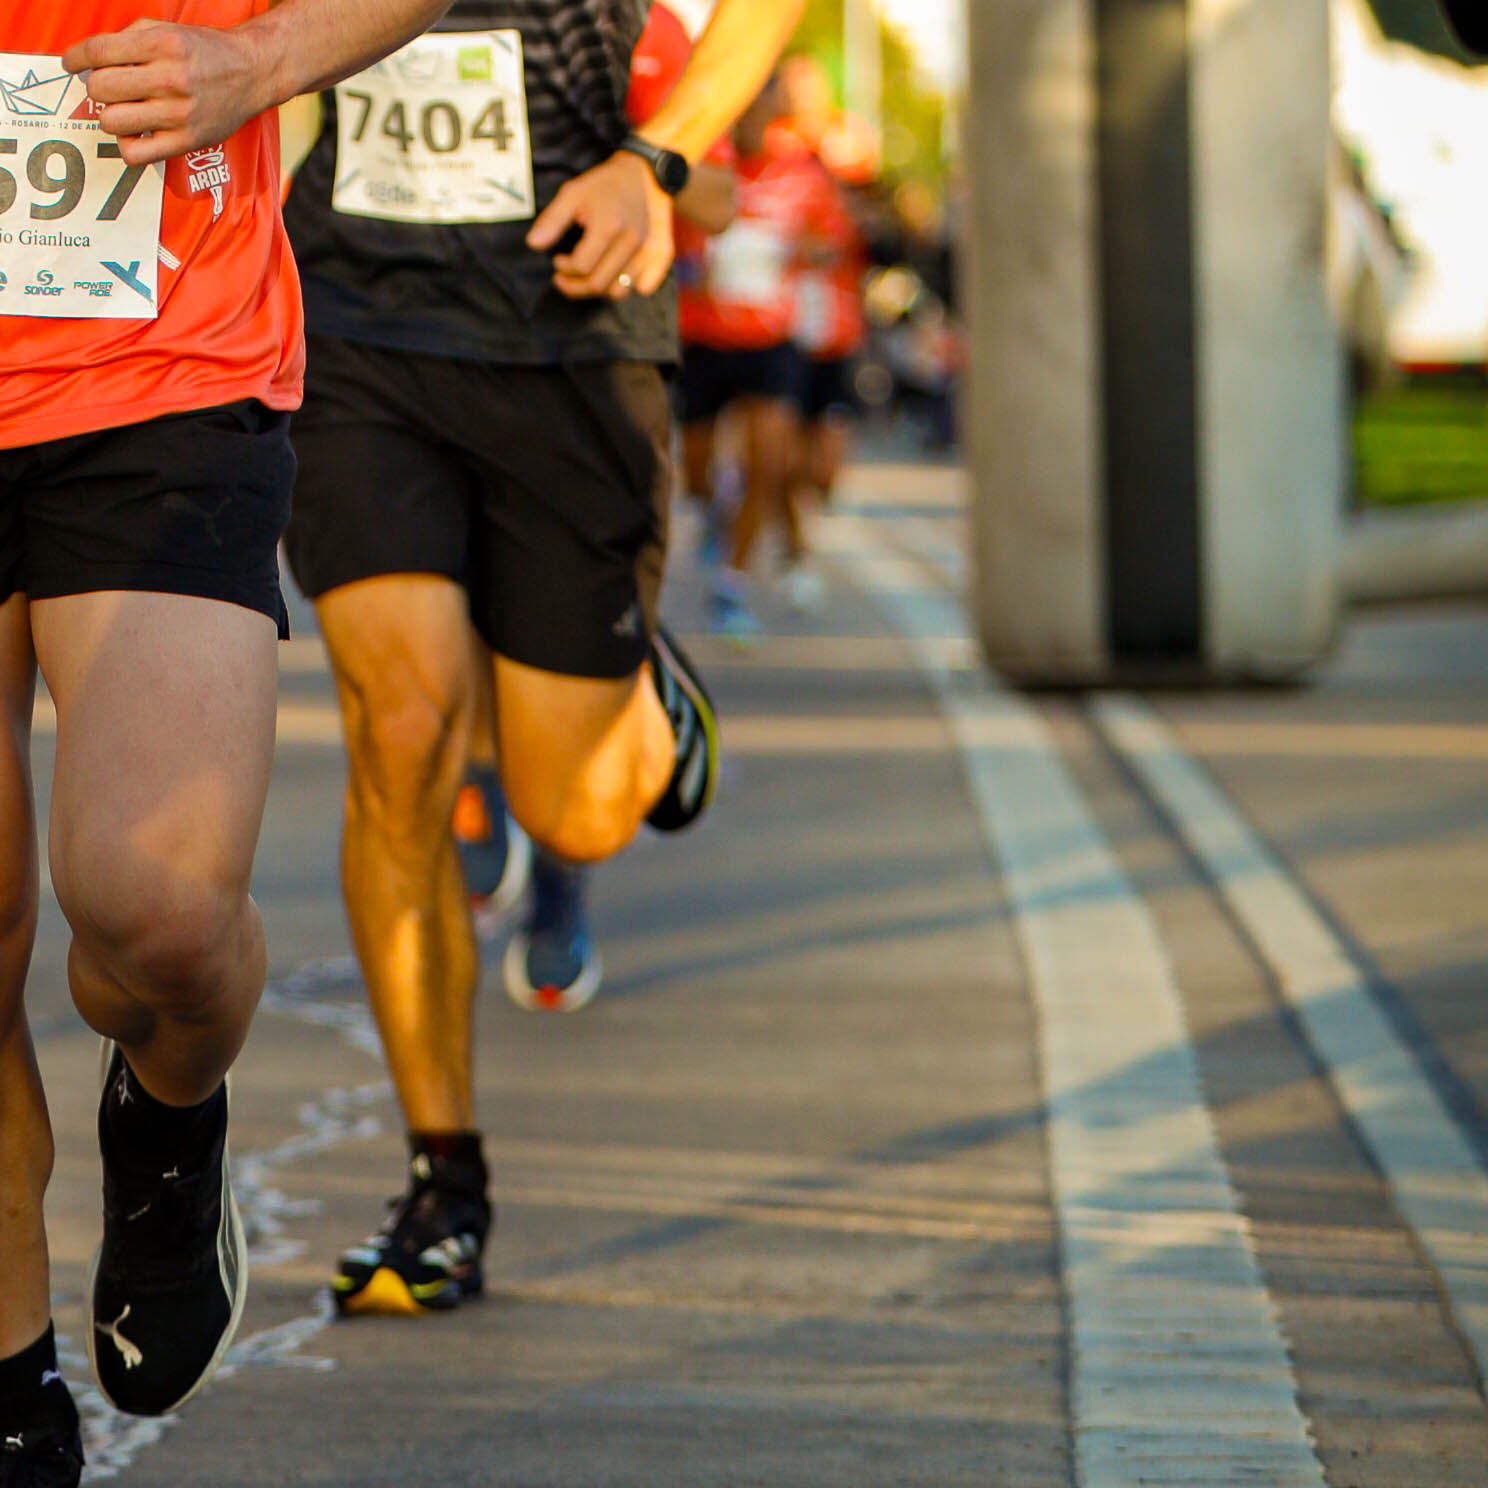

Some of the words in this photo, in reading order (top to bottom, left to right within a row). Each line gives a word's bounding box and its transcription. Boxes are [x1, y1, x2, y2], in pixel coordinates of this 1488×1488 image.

[11, 120, 49, 129] ROSARIO
[72, 122, 83, 130] DE
[344, 88, 514, 154] 7404
[18, 228, 91, 248] Gianluca
[73, 281, 114, 290] POWER
